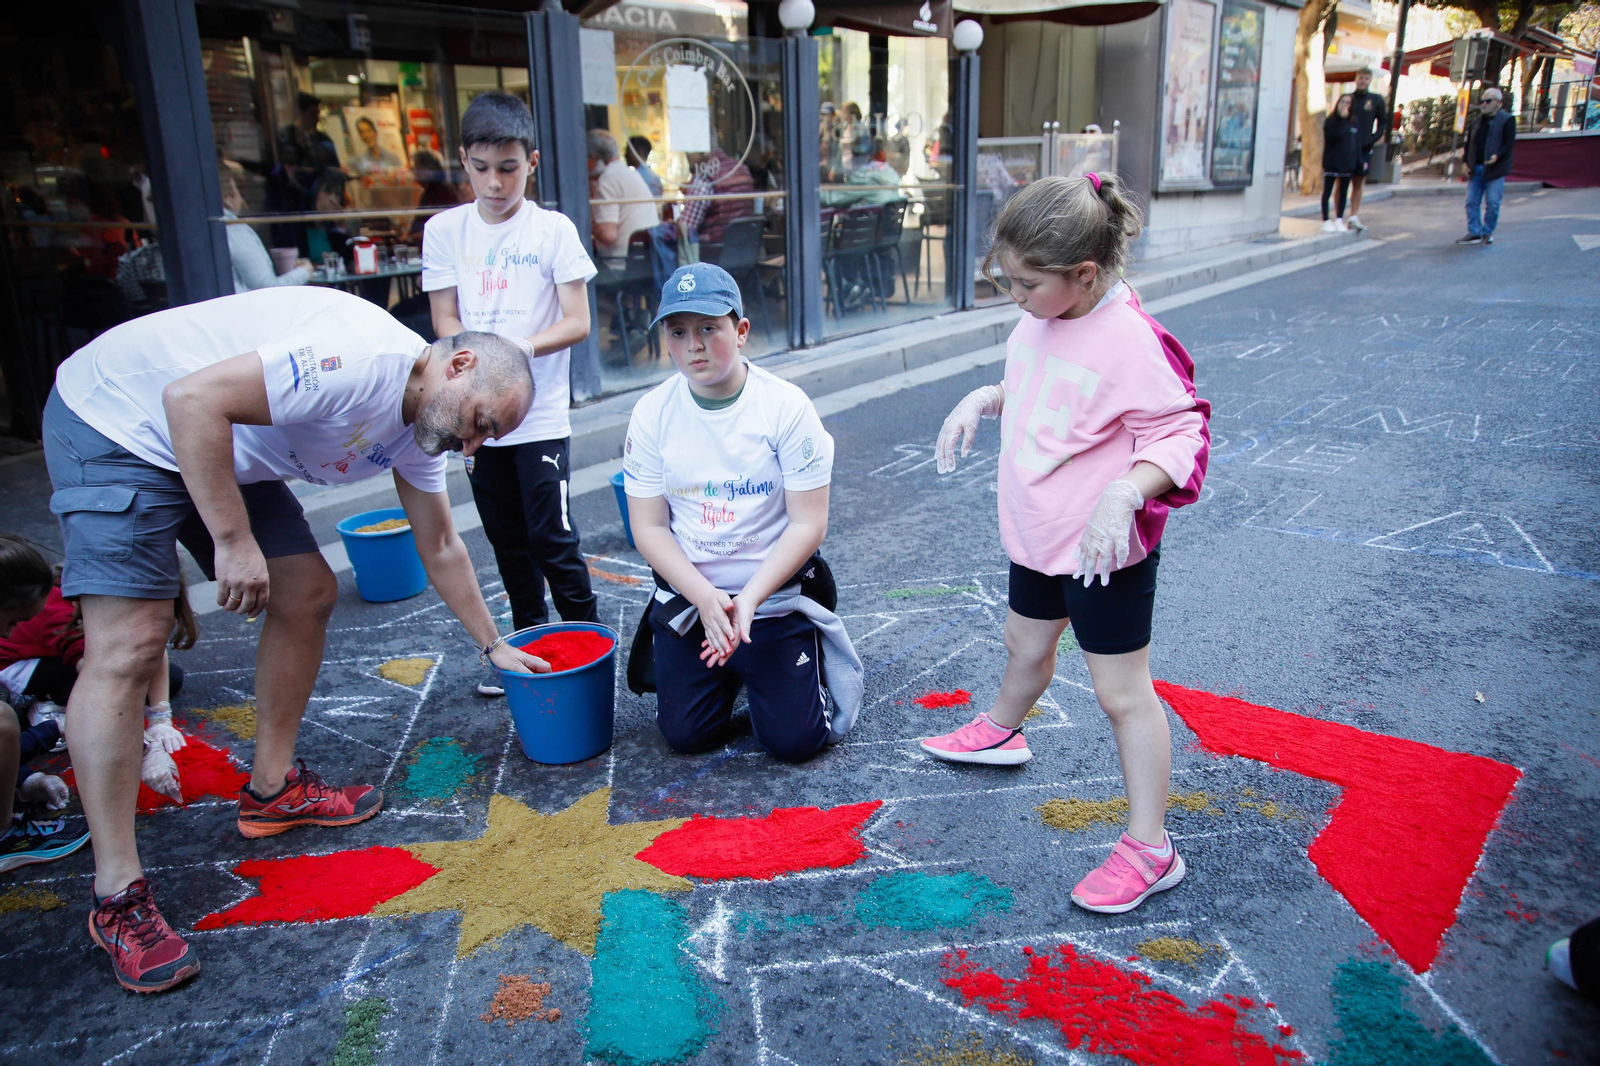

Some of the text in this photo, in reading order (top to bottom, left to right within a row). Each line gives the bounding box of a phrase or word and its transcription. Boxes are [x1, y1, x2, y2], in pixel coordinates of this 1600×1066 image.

[594, 4, 677, 31] ACIA
[637, 44, 735, 93] Café Coimbra Bar
[693, 157, 721, 178] 1969
[484, 247, 496, 266] de
[298, 348, 312, 392] DE ALMERÍA
[305, 345, 320, 392] DIPUTACIÓN
[704, 480, 720, 497] de
[723, 475, 775, 501] Fátima
[728, 534, 759, 547] TURÍSTICO
